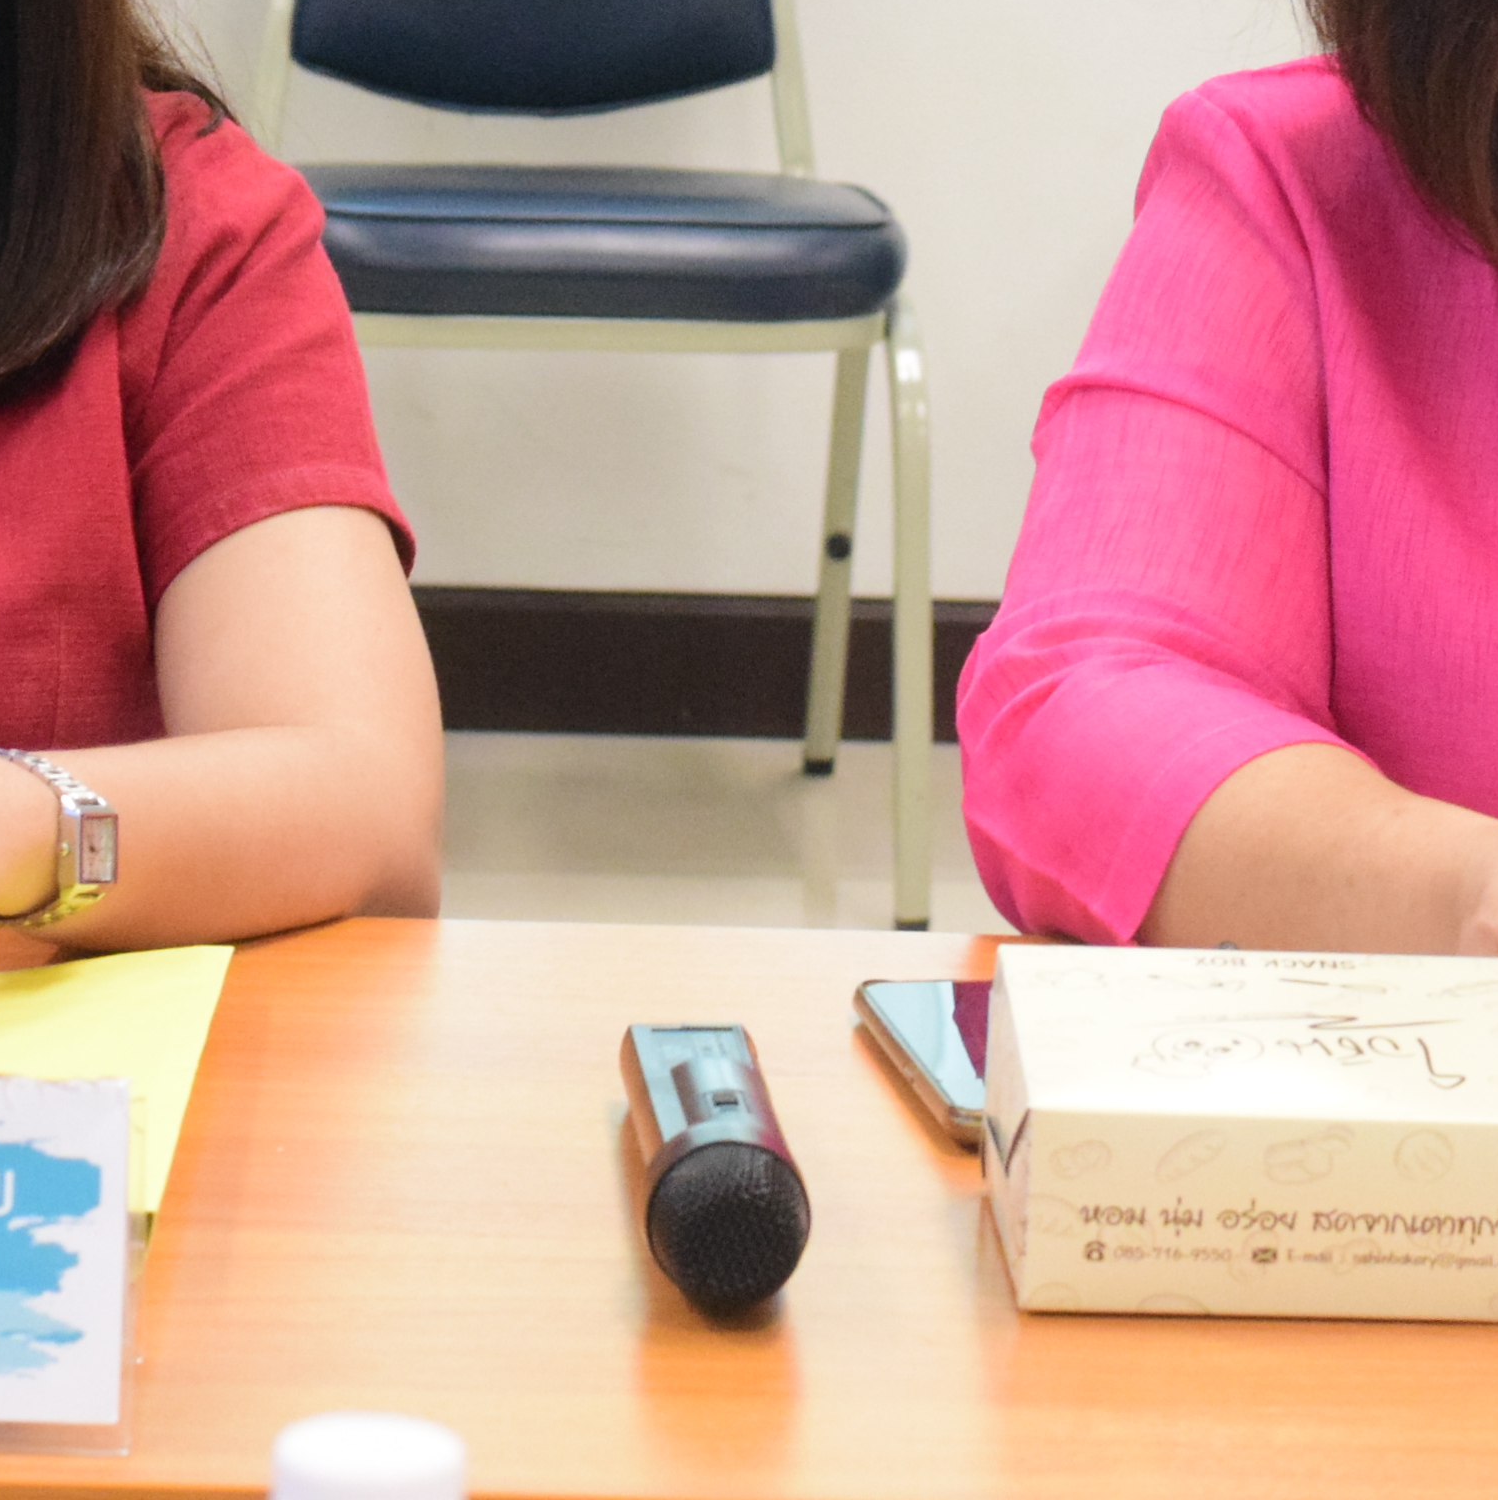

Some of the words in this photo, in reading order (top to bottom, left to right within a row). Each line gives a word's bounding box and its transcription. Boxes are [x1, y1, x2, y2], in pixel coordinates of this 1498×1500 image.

[1080, 1203, 1147, 1227] หอม
[1159, 1197, 1205, 1238] นุ่ม
[1216, 1198, 1298, 1232] อร่อย
